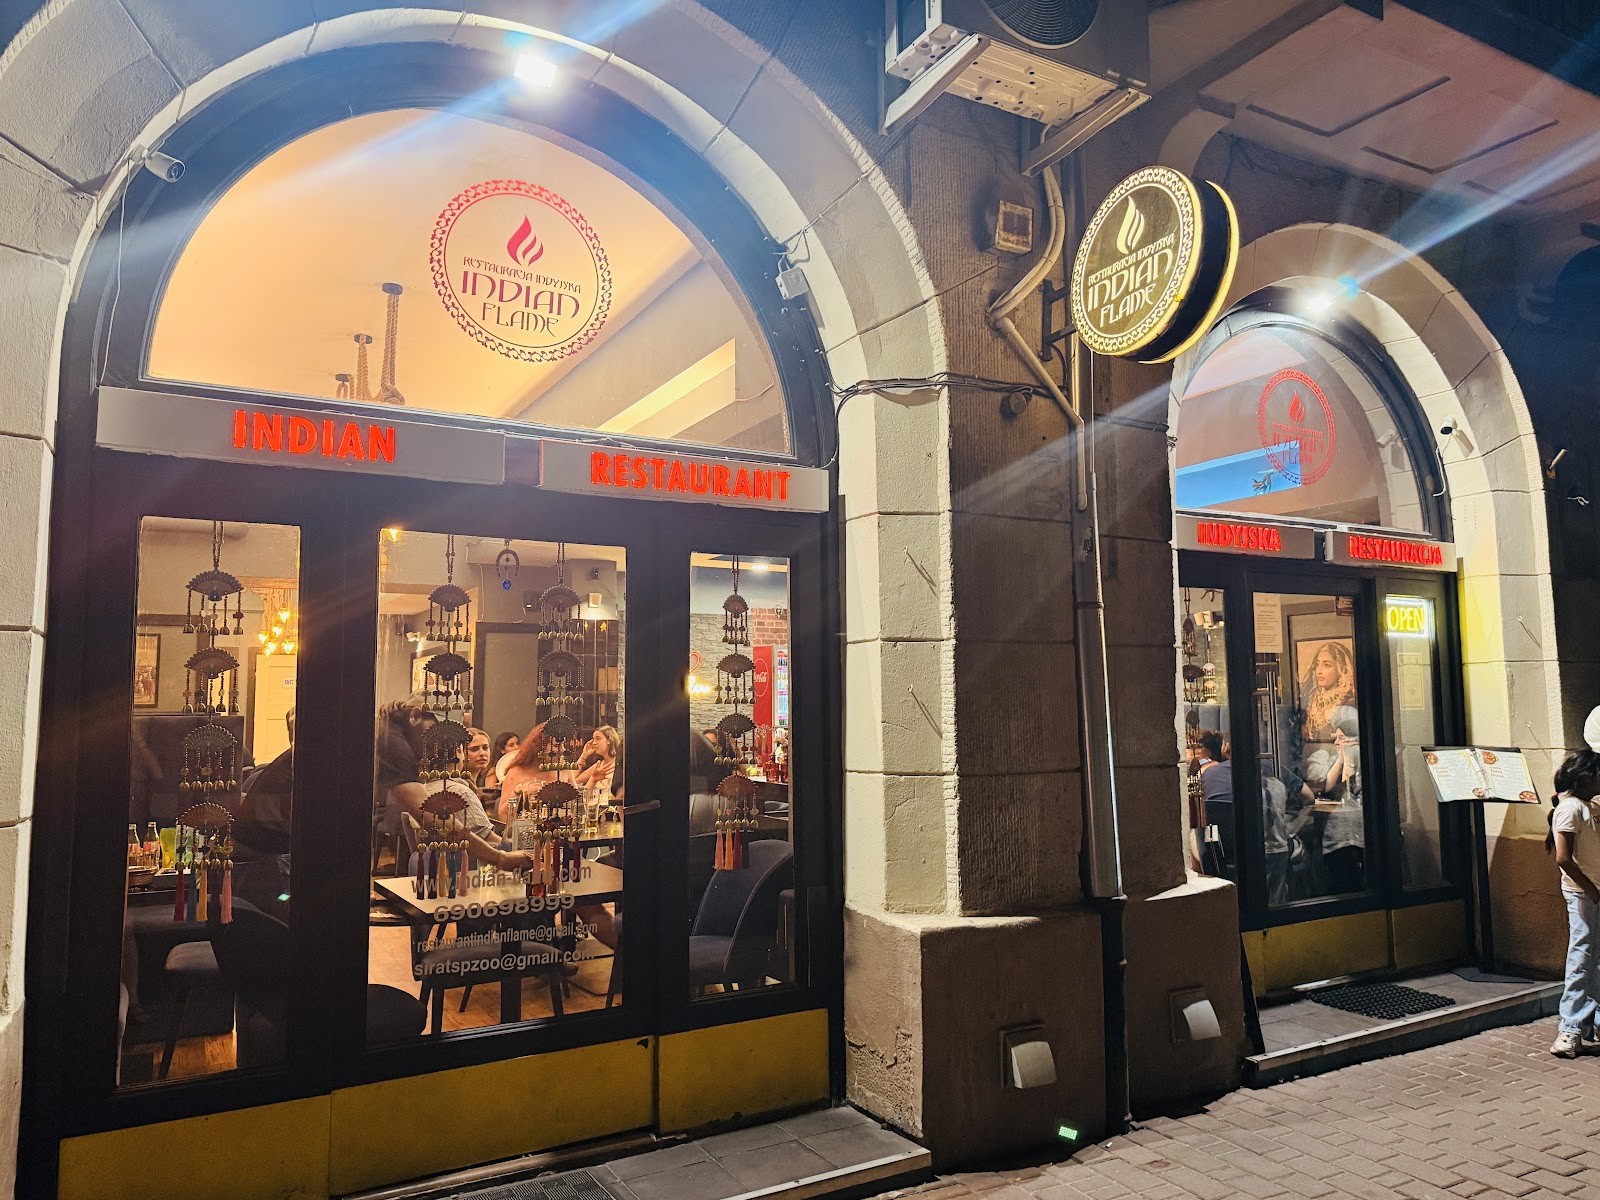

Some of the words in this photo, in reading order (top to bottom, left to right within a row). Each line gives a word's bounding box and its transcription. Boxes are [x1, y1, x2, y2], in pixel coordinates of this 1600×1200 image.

[463, 256, 533, 282] RESTAURACJA
[535, 274, 581, 294] INDYJSKA
[1087, 248, 1173, 313] INDIAN
[1088, 252, 1137, 287] RESTAURACJA
[1137, 232, 1175, 261] INDYJSKA
[461, 270, 580, 319] INDIAN
[1100, 282, 1157, 328] FLAME
[481, 302, 559, 338] FLAME
[232, 409, 396, 463] INDIAN
[590, 451, 792, 502] RESTAURANT
[1197, 521, 1282, 552] INDYJSKA
[1348, 535, 1443, 566] RESTAURACJA
[1387, 605, 1424, 632] OPEN
[433, 893, 575, 922] 690698999
